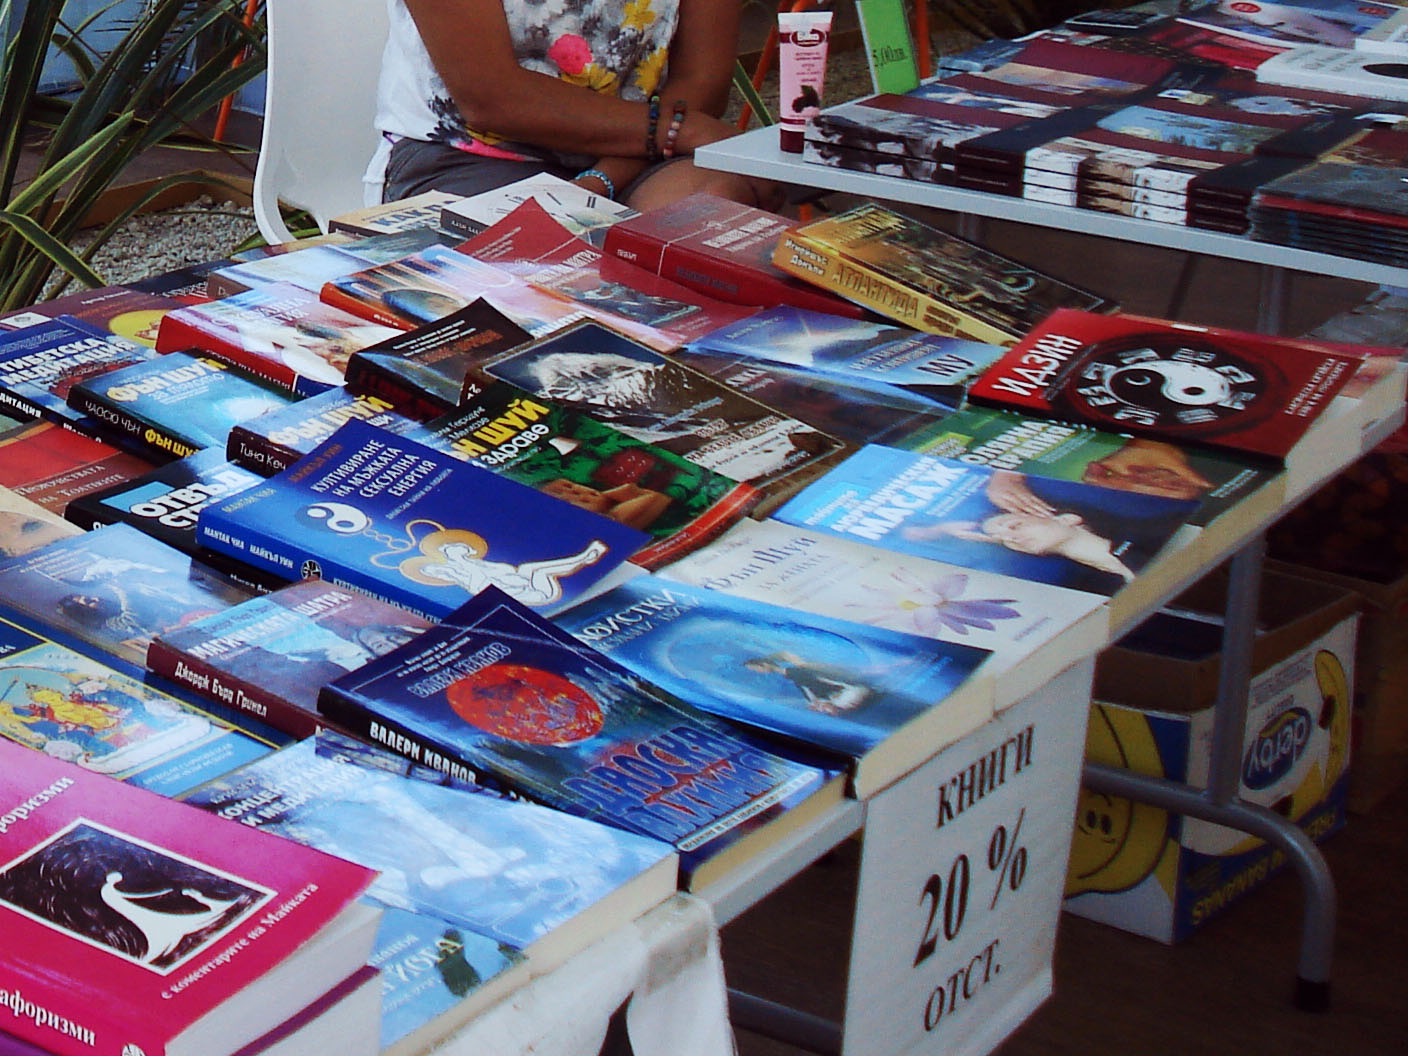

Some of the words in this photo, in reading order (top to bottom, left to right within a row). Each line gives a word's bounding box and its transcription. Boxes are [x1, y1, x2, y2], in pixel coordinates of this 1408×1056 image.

[0, 342, 137, 386] МЕДИТАЦИЯ
[916, 354, 975, 377] МУ
[992, 333, 1083, 396] ИДЗИН
[144, 428, 172, 452] ФЪН
[472, 398, 551, 447] ШУЙ
[958, 420, 1048, 465] ОЛЯРНА
[985, 422, 1077, 470] ЕРАПИЯ
[239, 442, 264, 463] Тина
[310, 439, 385, 493] КУЛТИВИРАНЕ
[333, 483, 354, 497] НА
[349, 446, 404, 489] МЪЖКАТА
[359, 453, 421, 498] СЕКСУАЛНА
[129, 469, 255, 519] ОТВЪД
[388, 459, 438, 497] ЕНЕРГИЯ
[847, 461, 970, 542] МАСАЖ
[369, 720, 421, 761] ВАЛЕРИ
[423, 748, 477, 785] ИВАНОВ
[936, 722, 1035, 829] КНИГИ
[912, 853, 970, 969] 20
[987, 807, 1028, 911] %
[169, 935, 251, 995] коментарите
[246, 926, 268, 943] на
[260, 882, 321, 930] Майката
[923, 937, 1002, 1032] ОТСТ.
